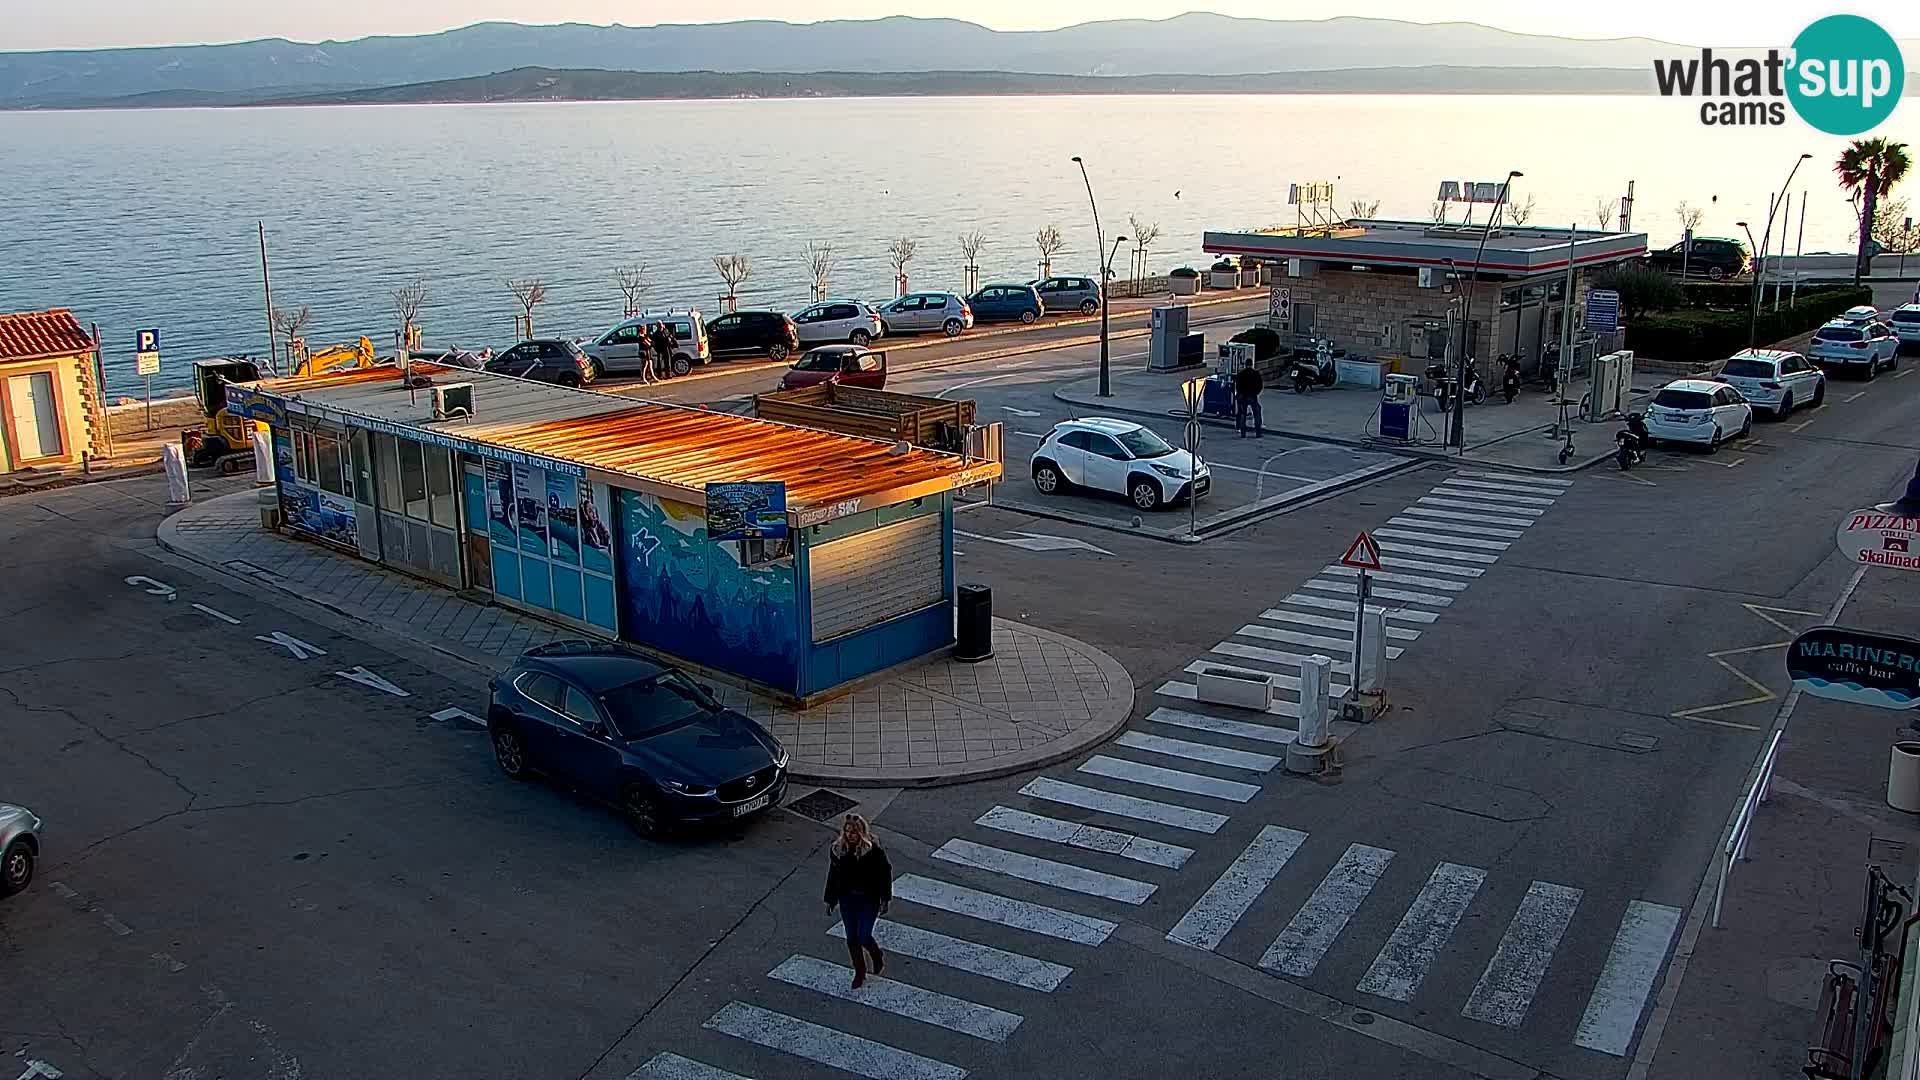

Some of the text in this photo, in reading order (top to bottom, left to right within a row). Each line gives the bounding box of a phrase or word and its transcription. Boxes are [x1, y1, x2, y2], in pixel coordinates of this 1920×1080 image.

[141, 332, 154, 350] P
[396, 427, 436, 443] AUTOBUSNA
[437, 435, 467, 450] POSTAJA
[478, 445, 493, 457] BUS
[494, 448, 526, 464] STATION
[528, 456, 554, 470] TICKET
[556, 462, 582, 476] OFFICE
[1847, 514, 1920, 532] PIZZE
[1881, 530, 1915, 540] GRILL
[1827, 662, 1896, 680] caffe bar
